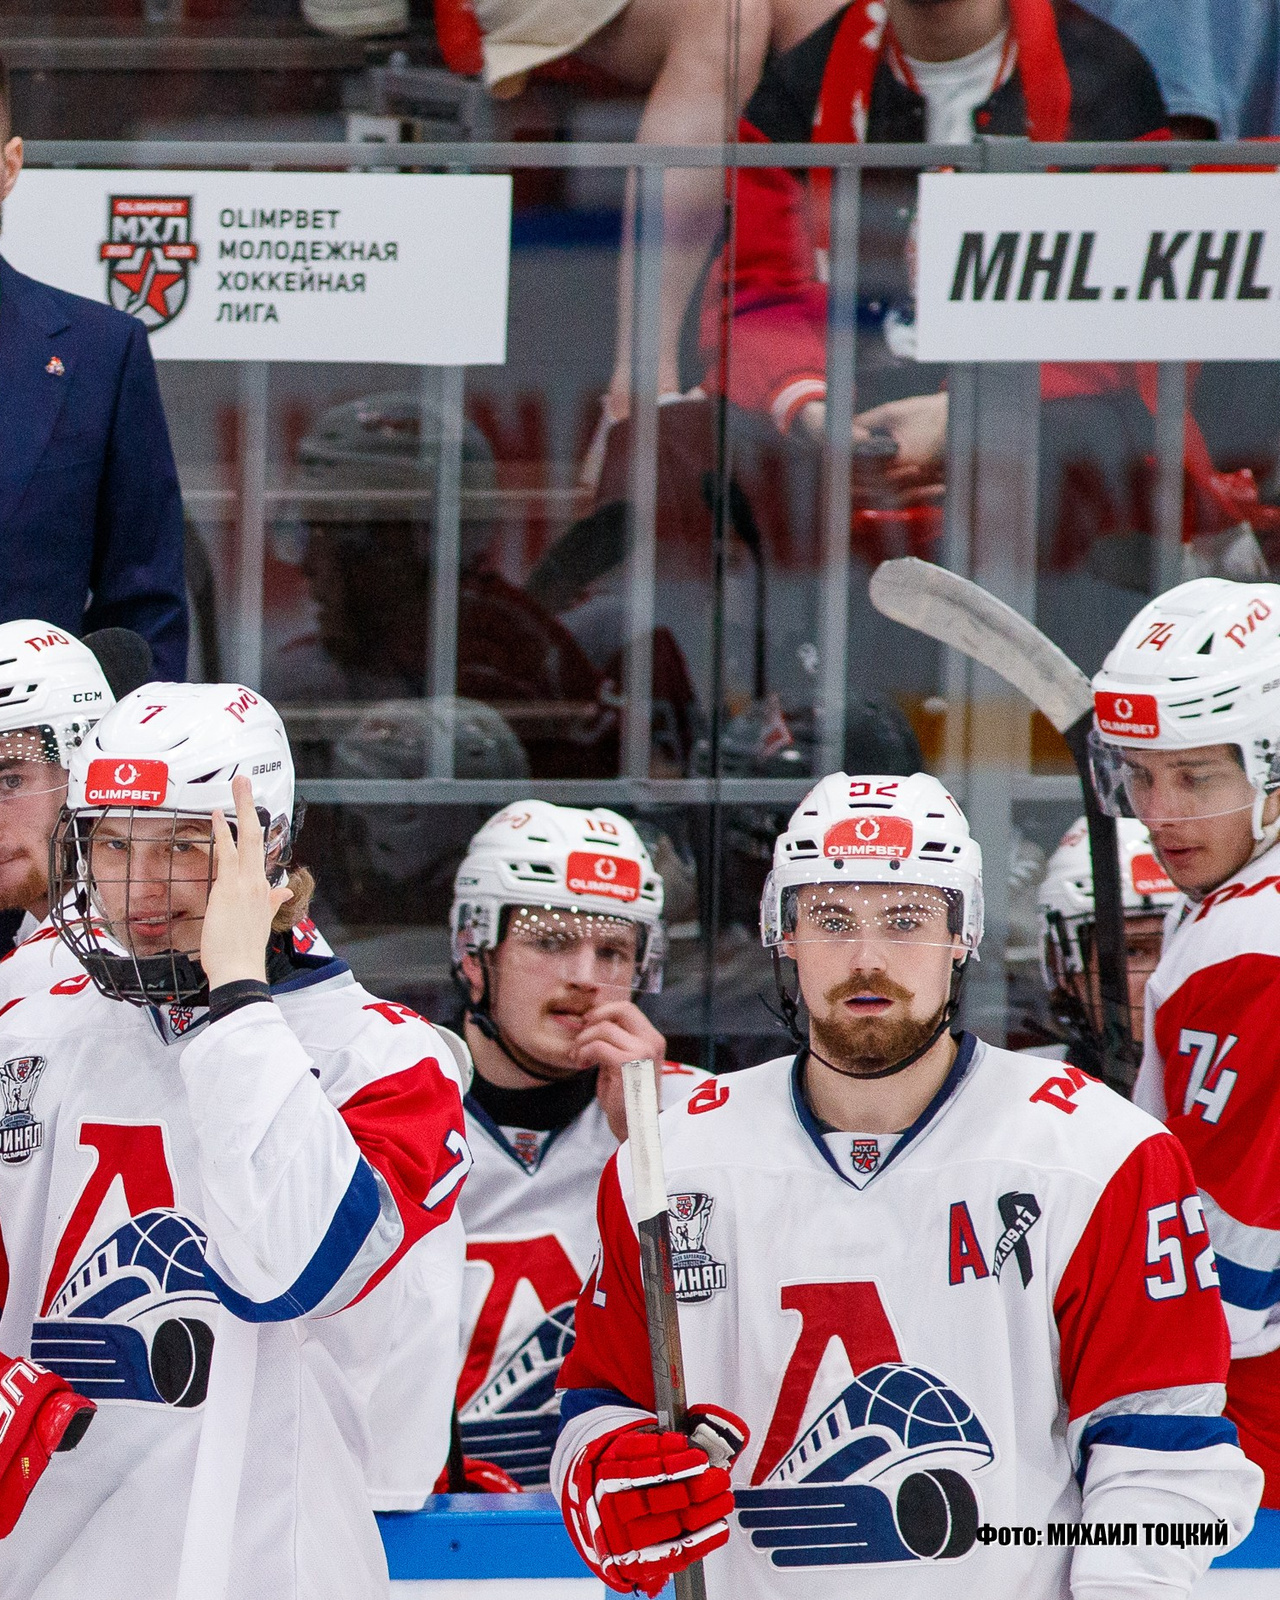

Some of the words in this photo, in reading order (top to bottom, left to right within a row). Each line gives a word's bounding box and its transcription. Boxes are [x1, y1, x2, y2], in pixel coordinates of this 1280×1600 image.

[112, 216, 188, 242] МХЛ
[219, 209, 341, 229] OLIMPBET
[219, 241, 399, 263] МОЛОДЕЖНАЯ
[949, 231, 1272, 300] MHL.KHL
[217, 266, 367, 293] ХОККЕЙНАЯ
[216, 303, 280, 324] ЛИГА
[1137, 622, 1174, 652] 74
[73, 692, 103, 703] CCM
[139, 706, 167, 724] 7
[1100, 718, 1156, 736] OLIMPBET
[89, 789, 161, 801] OLIMPBET
[827, 844, 908, 858] OLIMPBET
[570, 876, 638, 897] OLIMPBET
[1178, 1028, 1238, 1124] 74
[949, 1200, 990, 1286] A
[993, 1209, 1037, 1278] 07.09.11
[1144, 1194, 1221, 1301] 52
[673, 1264, 726, 1292] ИНАЛ
